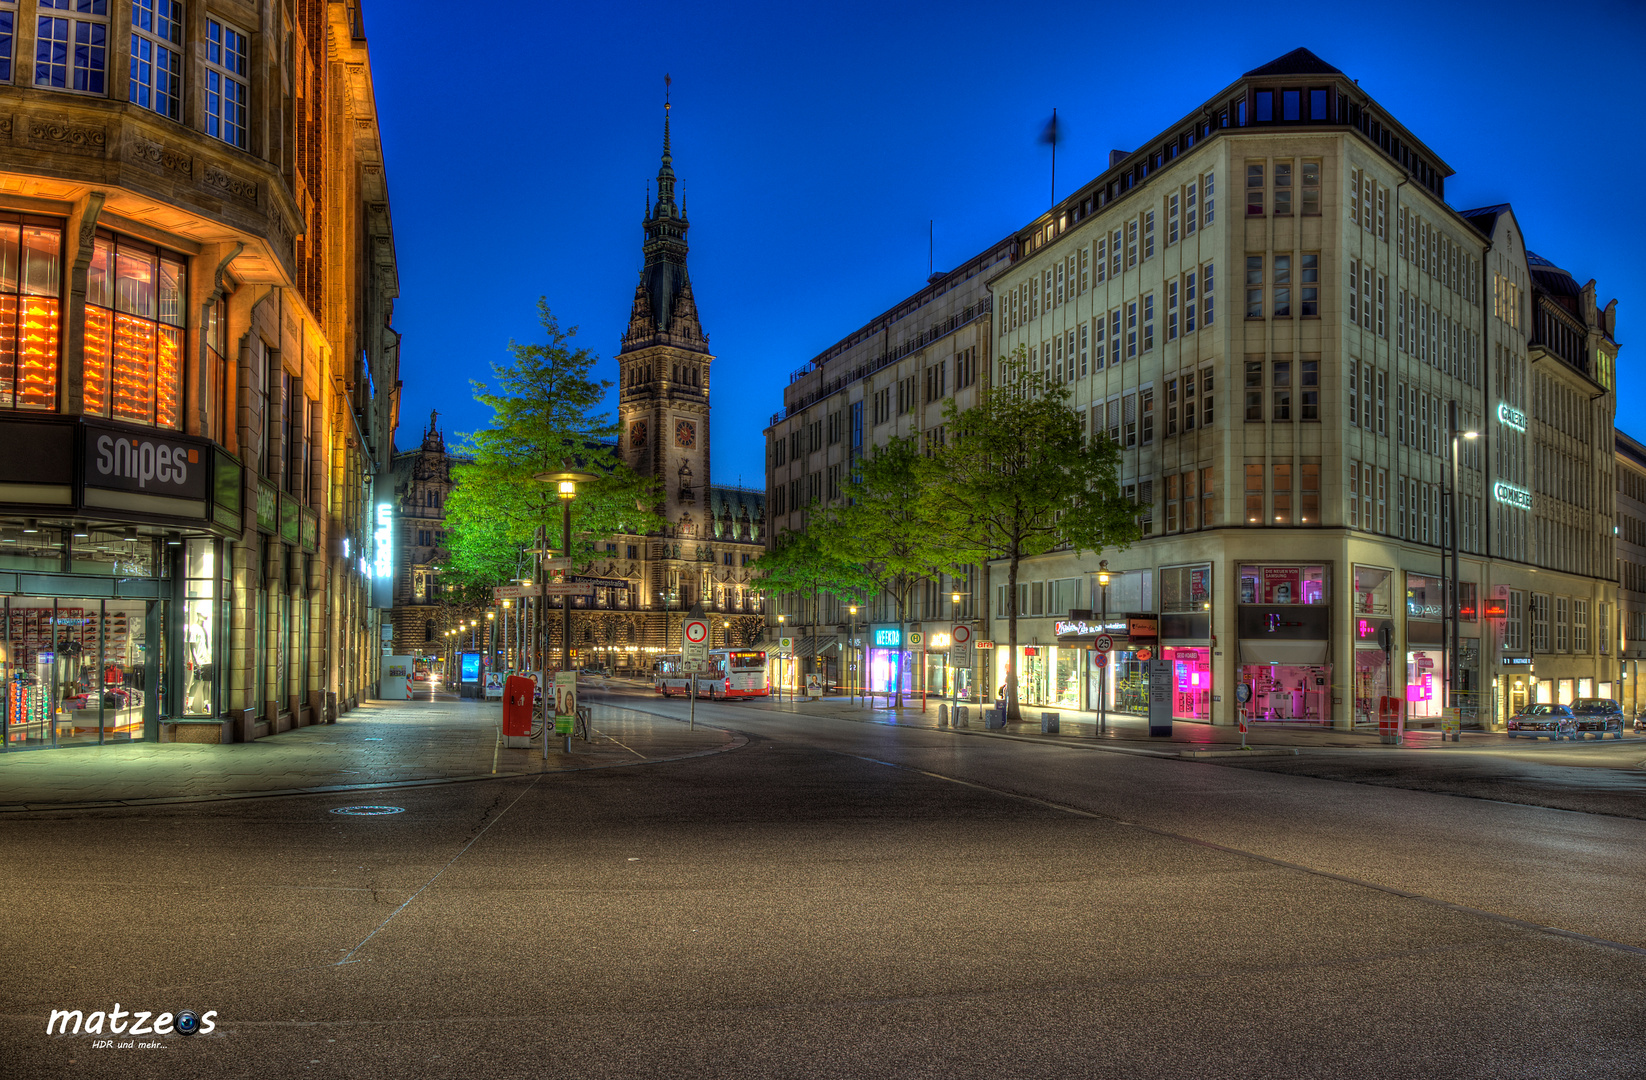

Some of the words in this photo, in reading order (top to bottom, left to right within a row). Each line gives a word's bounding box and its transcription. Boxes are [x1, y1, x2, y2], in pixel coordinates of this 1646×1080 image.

[97, 435, 187, 488] snipes
[375, 503, 392, 578] stadium
[575, 577, 625, 588] Mönckebergstraße
[1098, 639, 1110, 649] 25
